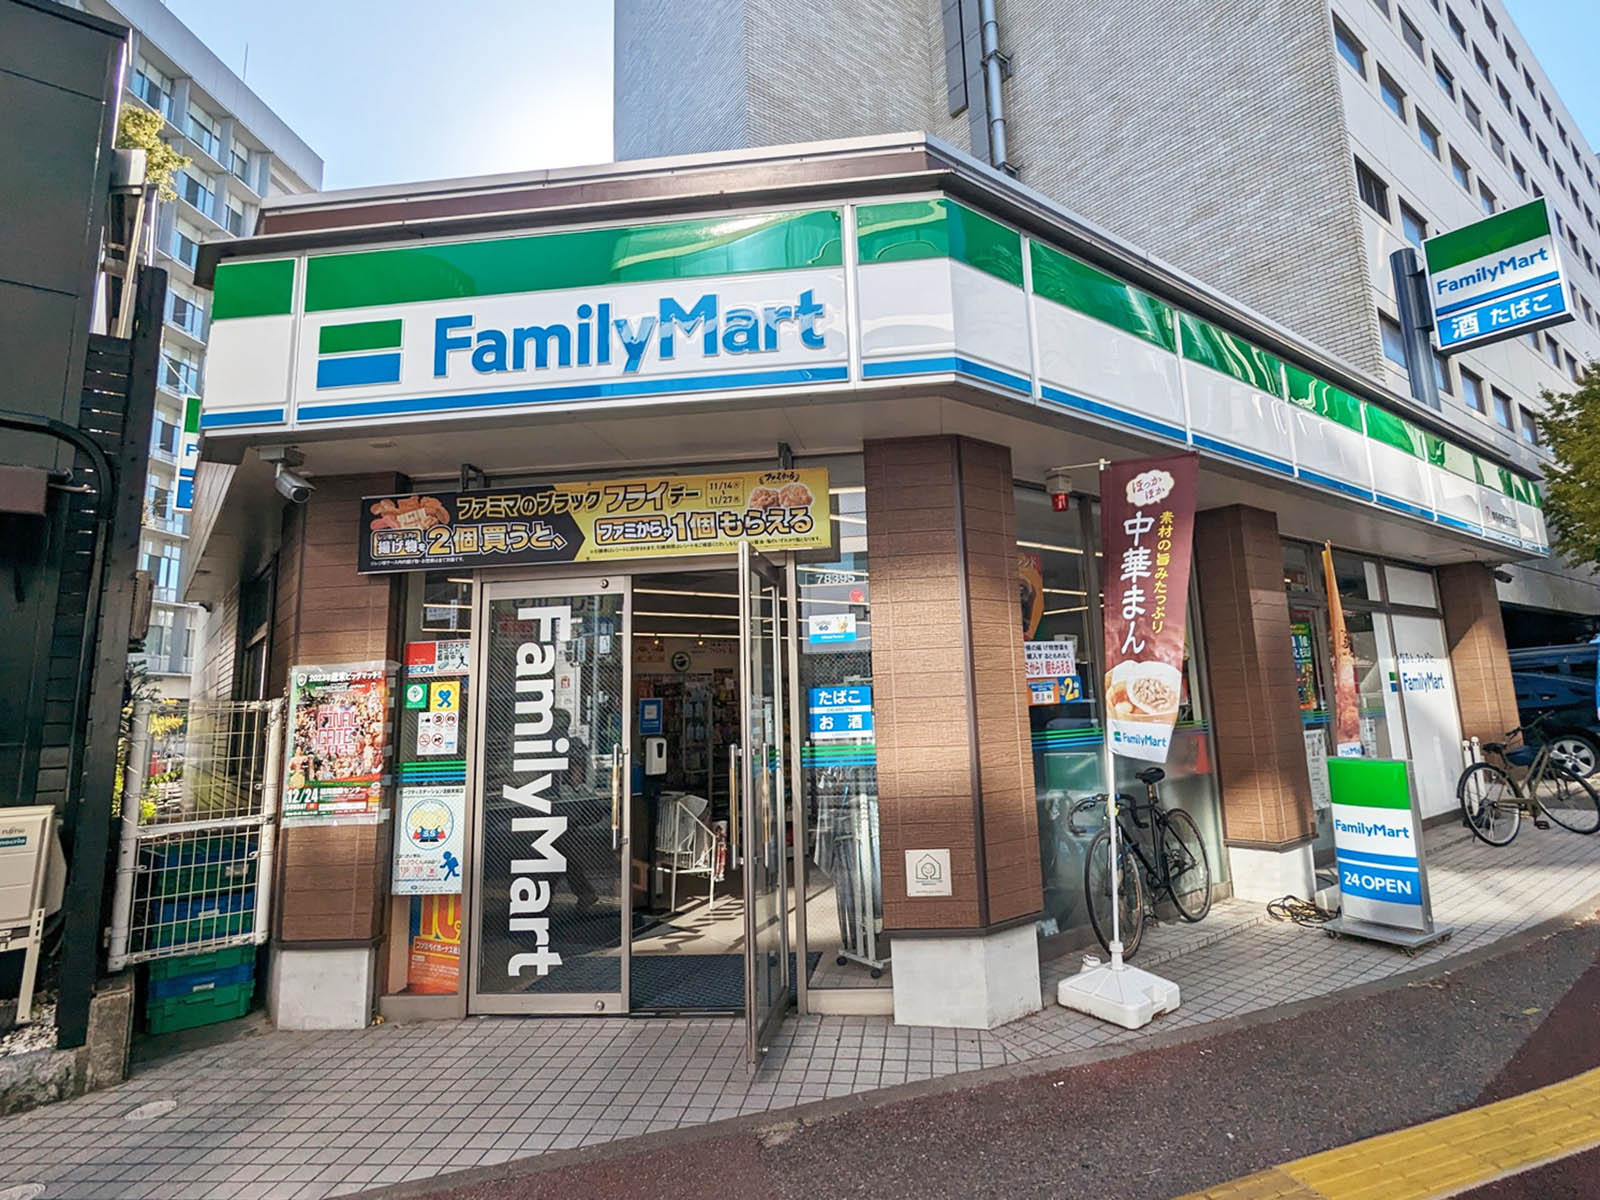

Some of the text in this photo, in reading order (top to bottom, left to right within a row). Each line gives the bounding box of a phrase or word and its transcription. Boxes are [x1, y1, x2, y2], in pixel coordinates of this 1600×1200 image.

[1437, 247, 1549, 296] FamilyMart
[433, 288, 827, 379] FamilyMart
[1451, 292, 1552, 339] 酒 たばこ
[815, 574, 856, 585] 78395
[1120, 510, 1156, 655] 中華まん
[1152, 510, 1175, 634] 素材の旨みたっぷり
[818, 689, 861, 705] たばこ
[1122, 731, 1167, 748] FamilyMart
[287, 787, 319, 803] 12/24
[502, 605, 571, 977] FamilyMart
[1335, 818, 1410, 839] FamilyMart
